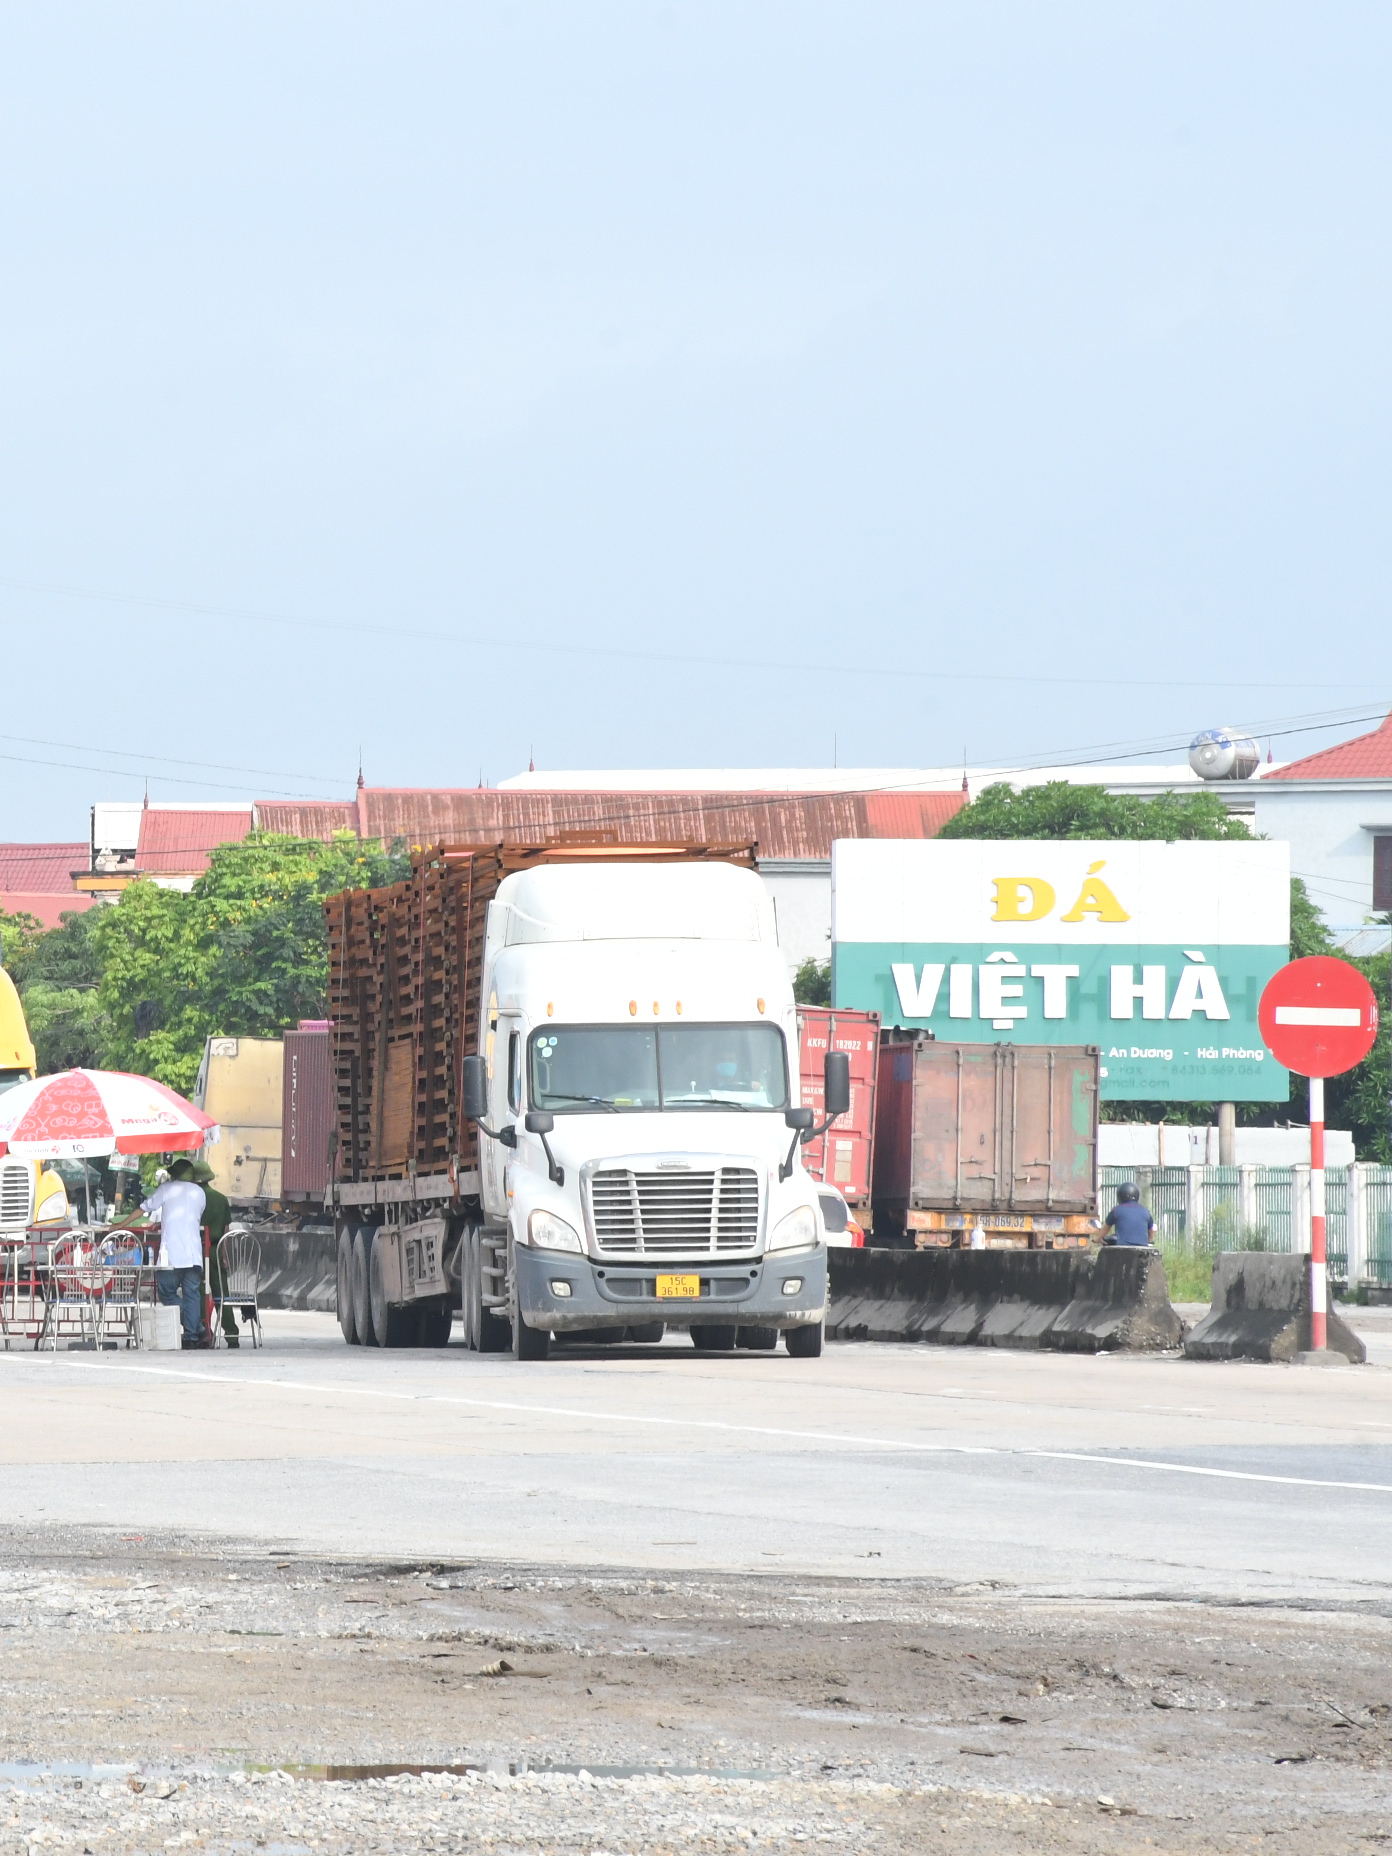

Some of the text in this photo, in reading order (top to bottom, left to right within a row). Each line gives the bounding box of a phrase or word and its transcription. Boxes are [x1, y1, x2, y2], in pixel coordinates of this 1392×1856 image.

[990, 860, 1131, 922] ĐÁ
[890, 950, 1230, 1030] VIỆT HÀ
[807, 1038, 827, 1048] KKFU
[1109, 1047, 1127, 1058] An
[1198, 1047, 1218, 1058] Hải
[1222, 1047, 1264, 1061] Phòng
[670, 1276, 686, 1286] 15C
[661, 1286, 695, 1296] 361.98
